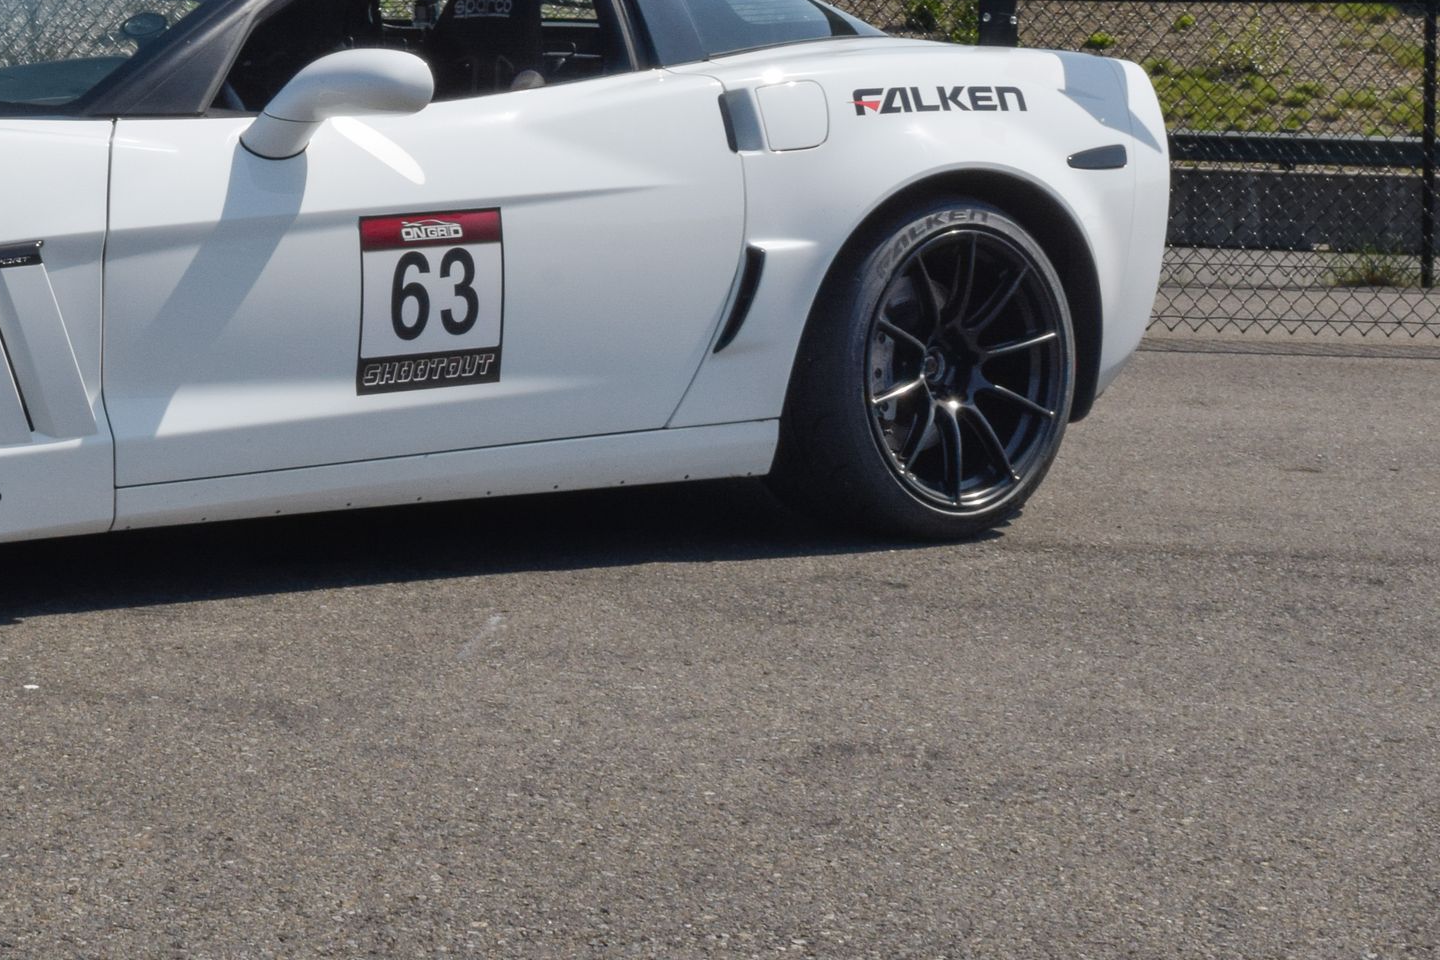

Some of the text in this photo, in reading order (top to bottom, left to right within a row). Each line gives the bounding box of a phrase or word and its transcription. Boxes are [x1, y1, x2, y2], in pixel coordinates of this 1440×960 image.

[852, 85, 1027, 116] FALKEN
[391, 247, 479, 341] 63
[362, 353, 494, 386] SHOOTOUT
